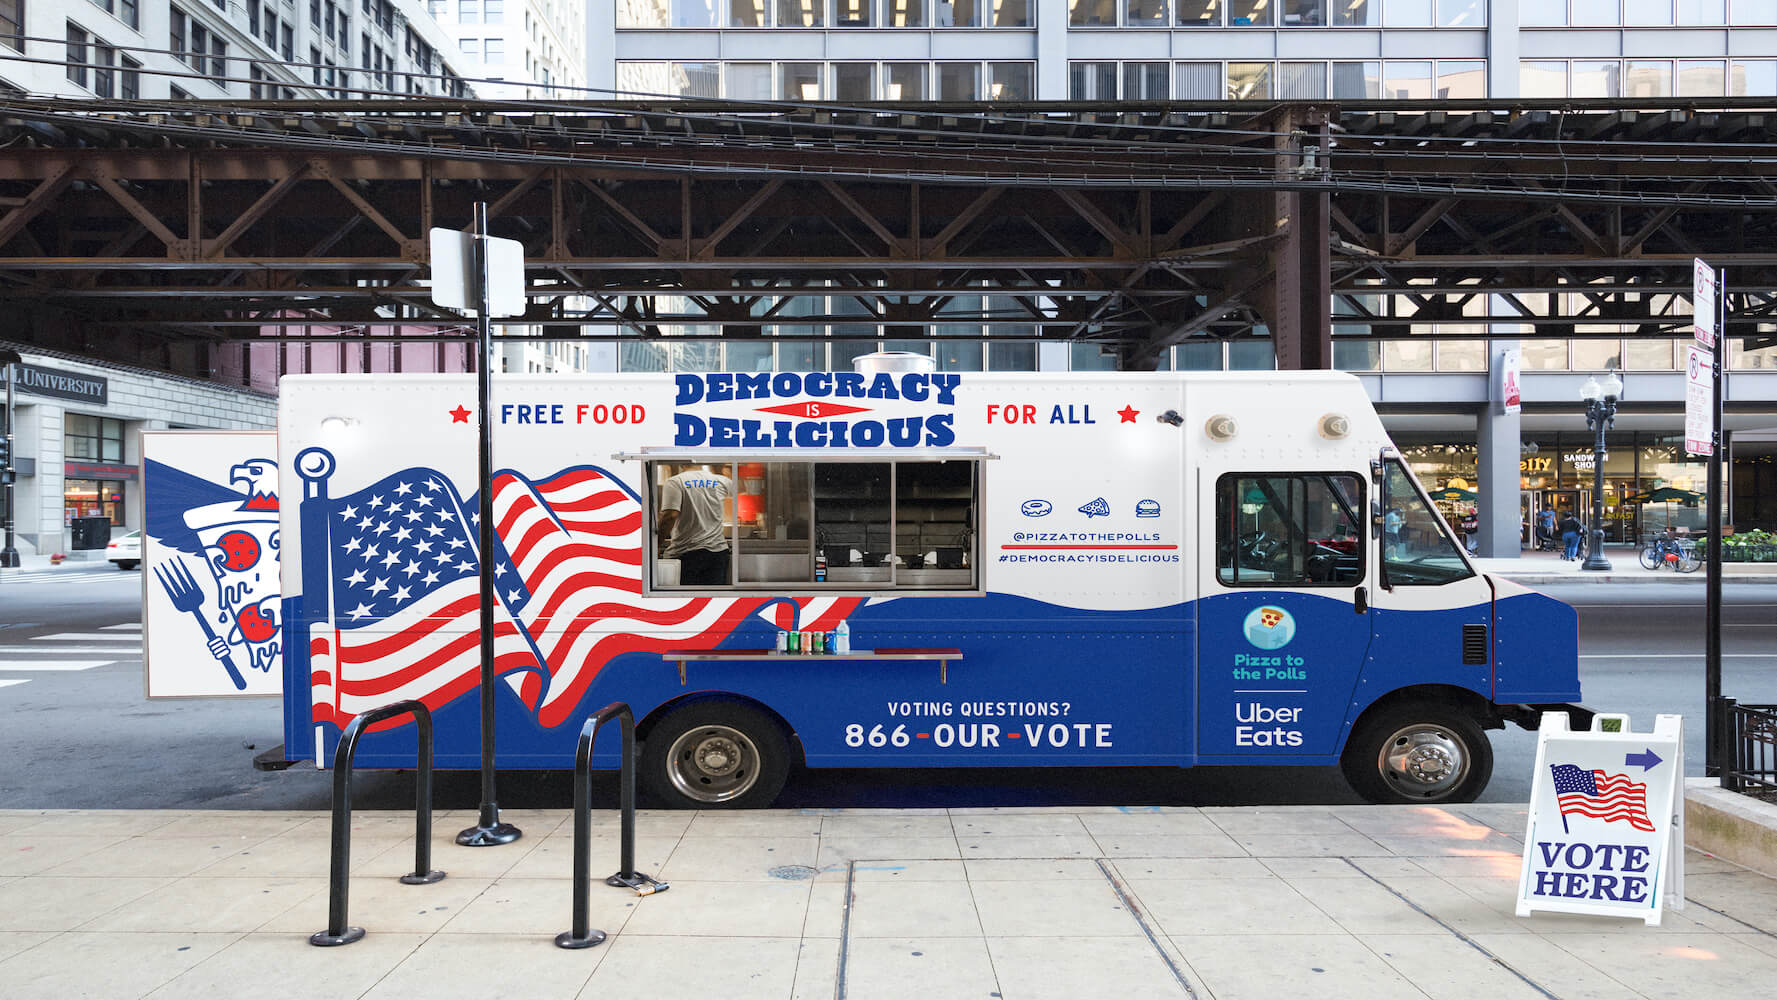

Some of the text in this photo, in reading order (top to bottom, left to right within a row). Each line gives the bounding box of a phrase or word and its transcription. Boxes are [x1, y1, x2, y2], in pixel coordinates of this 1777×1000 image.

[23, 368, 104, 396] UNIVERSITY
[675, 372, 961, 406] DEMOCRACY
[501, 404, 646, 424] FREE FOOD
[806, 403, 820, 417] IS
[987, 404, 1096, 424] FOR ALL
[674, 412, 956, 448] DELICIOUS
[1563, 453, 1609, 462] SANDWH
[684, 479, 720, 490] STAFF
[1013, 532, 1161, 542] @PIZZATOTHEPOLLS
[998, 554, 1180, 563] #DEMOCRACYISDELICIOUS
[1234, 653, 1305, 667] Pizza to
[1232, 667, 1307, 680] the Polls
[888, 701, 1071, 717] VOTING QUESTIONS?
[1235, 702, 1303, 723] Uber
[844, 723, 1113, 748] 866-OUR-VOTE
[1235, 726, 1304, 747] Eats
[1537, 841, 1651, 873] VOTE
[1533, 871, 1649, 903] HERE
